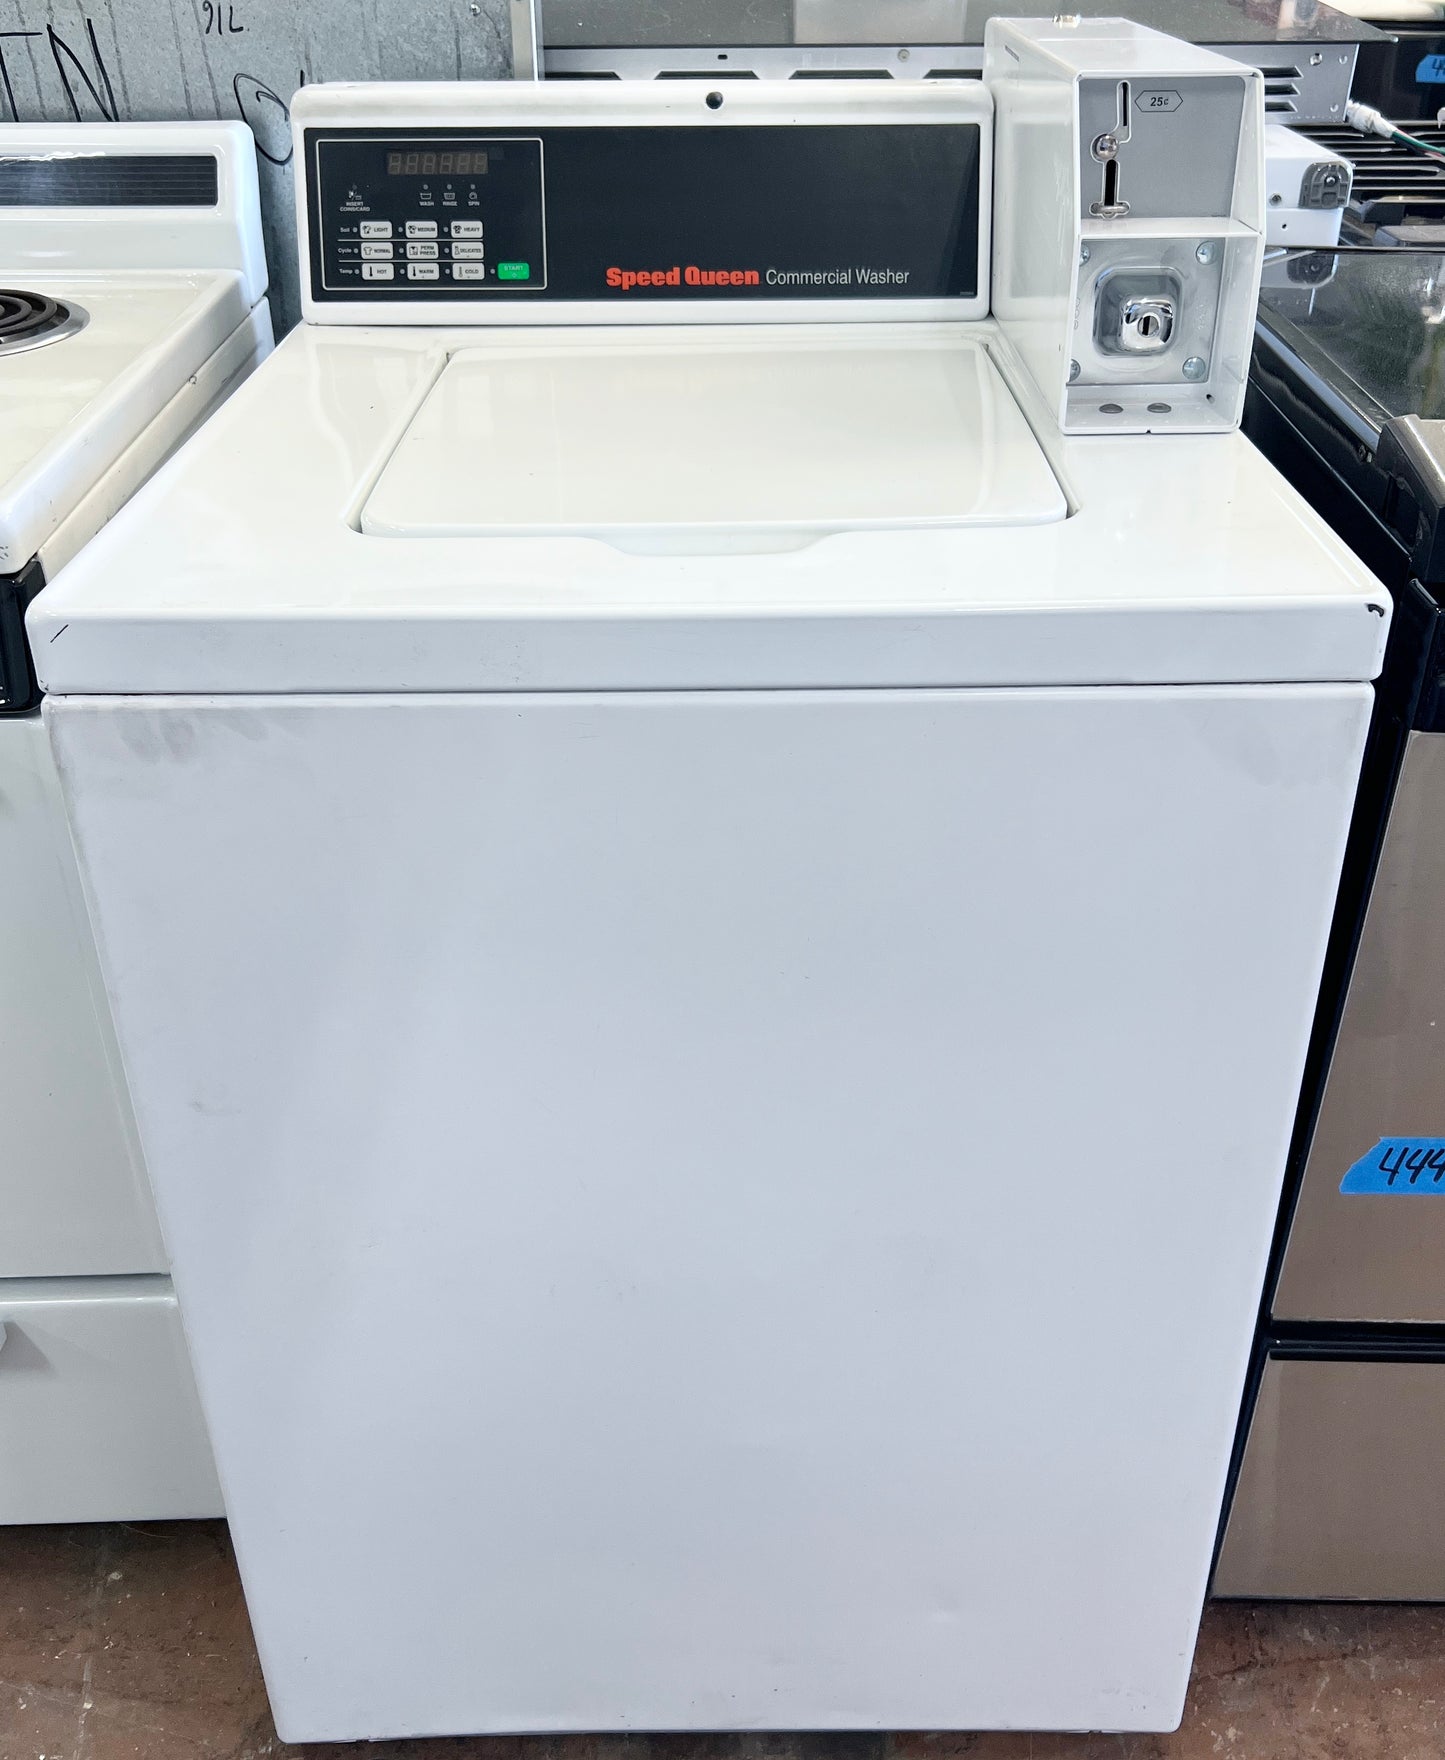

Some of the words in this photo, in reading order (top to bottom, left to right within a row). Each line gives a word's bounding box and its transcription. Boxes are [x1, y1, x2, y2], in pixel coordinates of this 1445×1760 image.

[605, 266, 681, 290] Speed
[684, 266, 760, 286] Queen
[765, 269, 852, 285] Commercial
[856, 268, 910, 285] Washer
